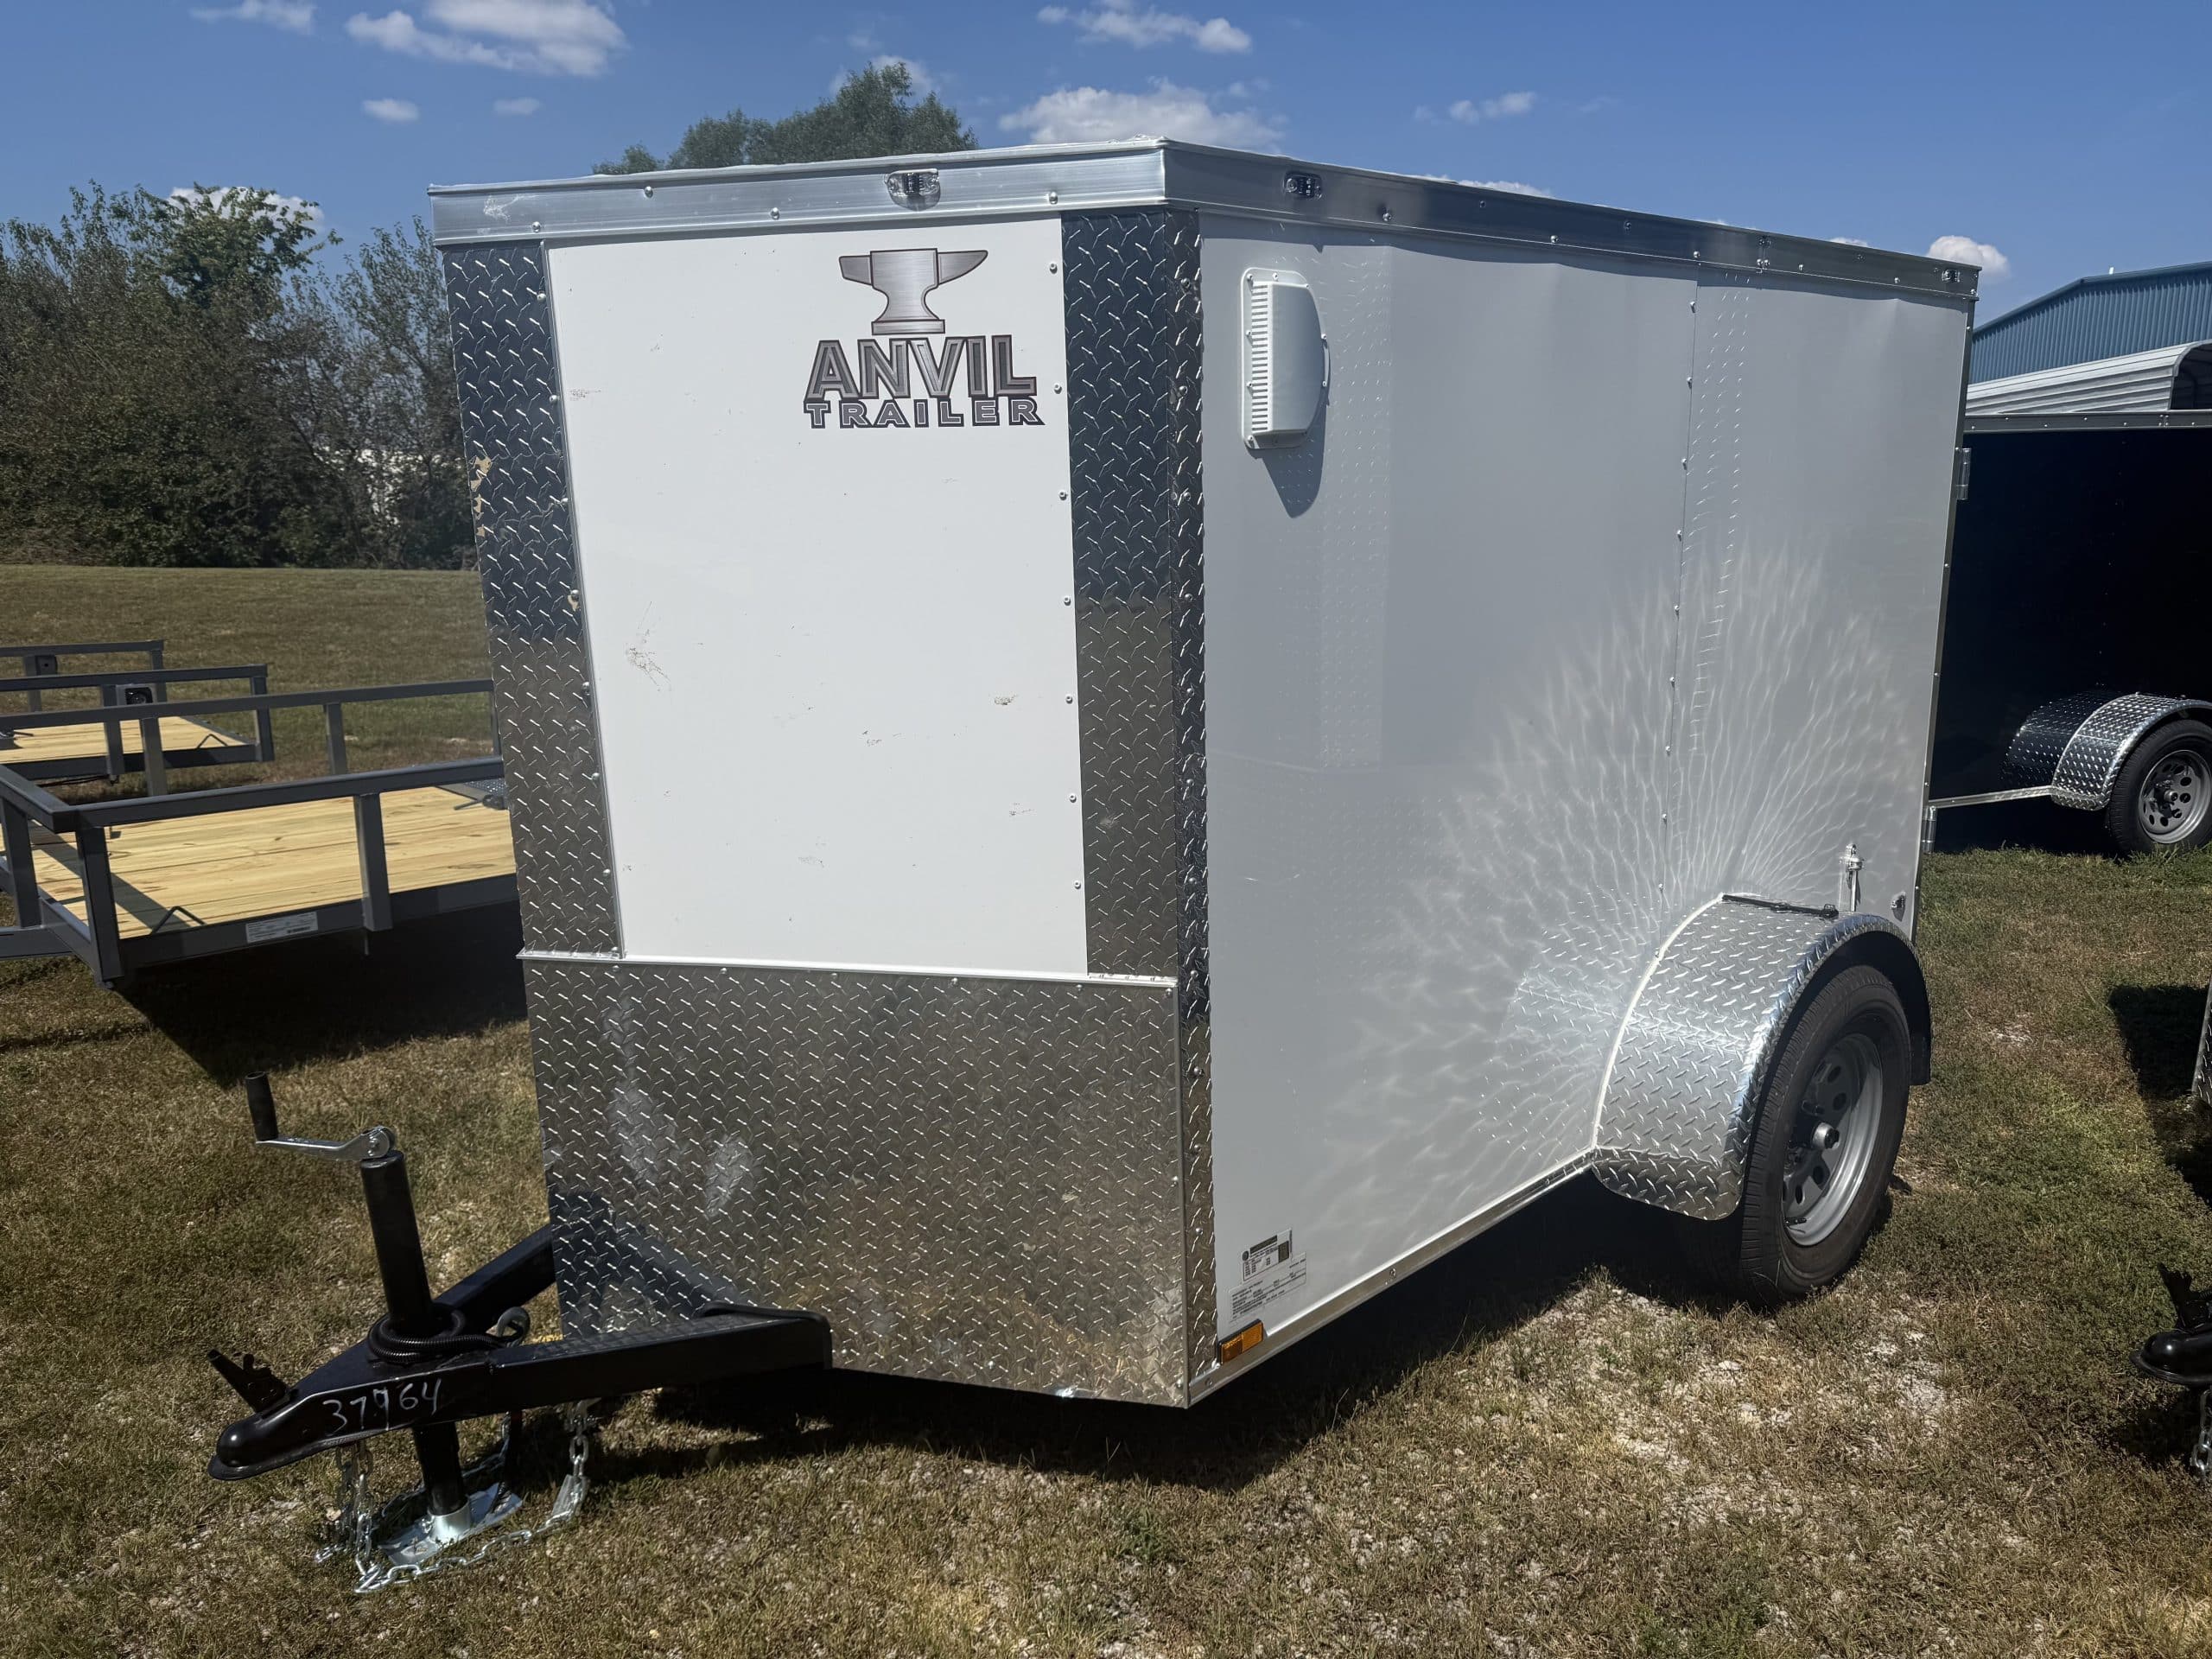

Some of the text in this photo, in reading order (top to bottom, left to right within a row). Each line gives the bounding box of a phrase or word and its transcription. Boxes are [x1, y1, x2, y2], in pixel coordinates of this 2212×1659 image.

[804, 334, 1037, 400] ANVIL
[804, 397, 1046, 429] TRAILER
[322, 1378, 442, 1436] 37964
